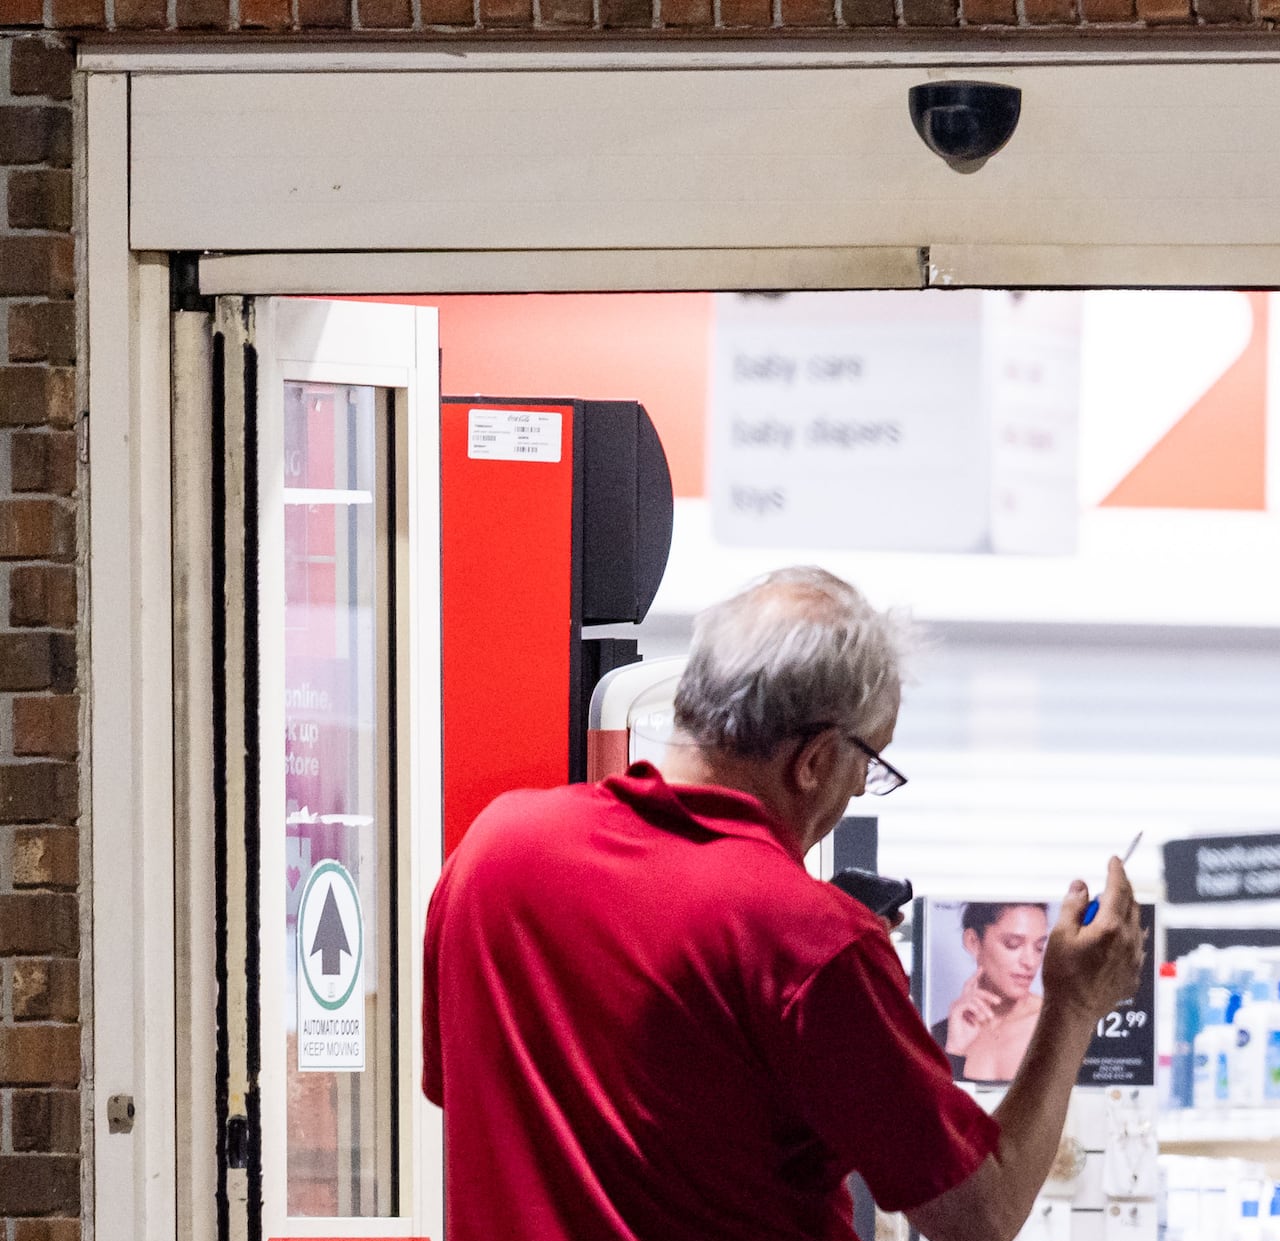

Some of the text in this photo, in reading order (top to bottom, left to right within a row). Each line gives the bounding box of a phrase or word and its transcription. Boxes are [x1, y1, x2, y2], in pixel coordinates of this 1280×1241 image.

[304, 1019, 360, 1036] AUTOMATIC DOOR
[304, 1041, 360, 1056] KEEP MOVING
